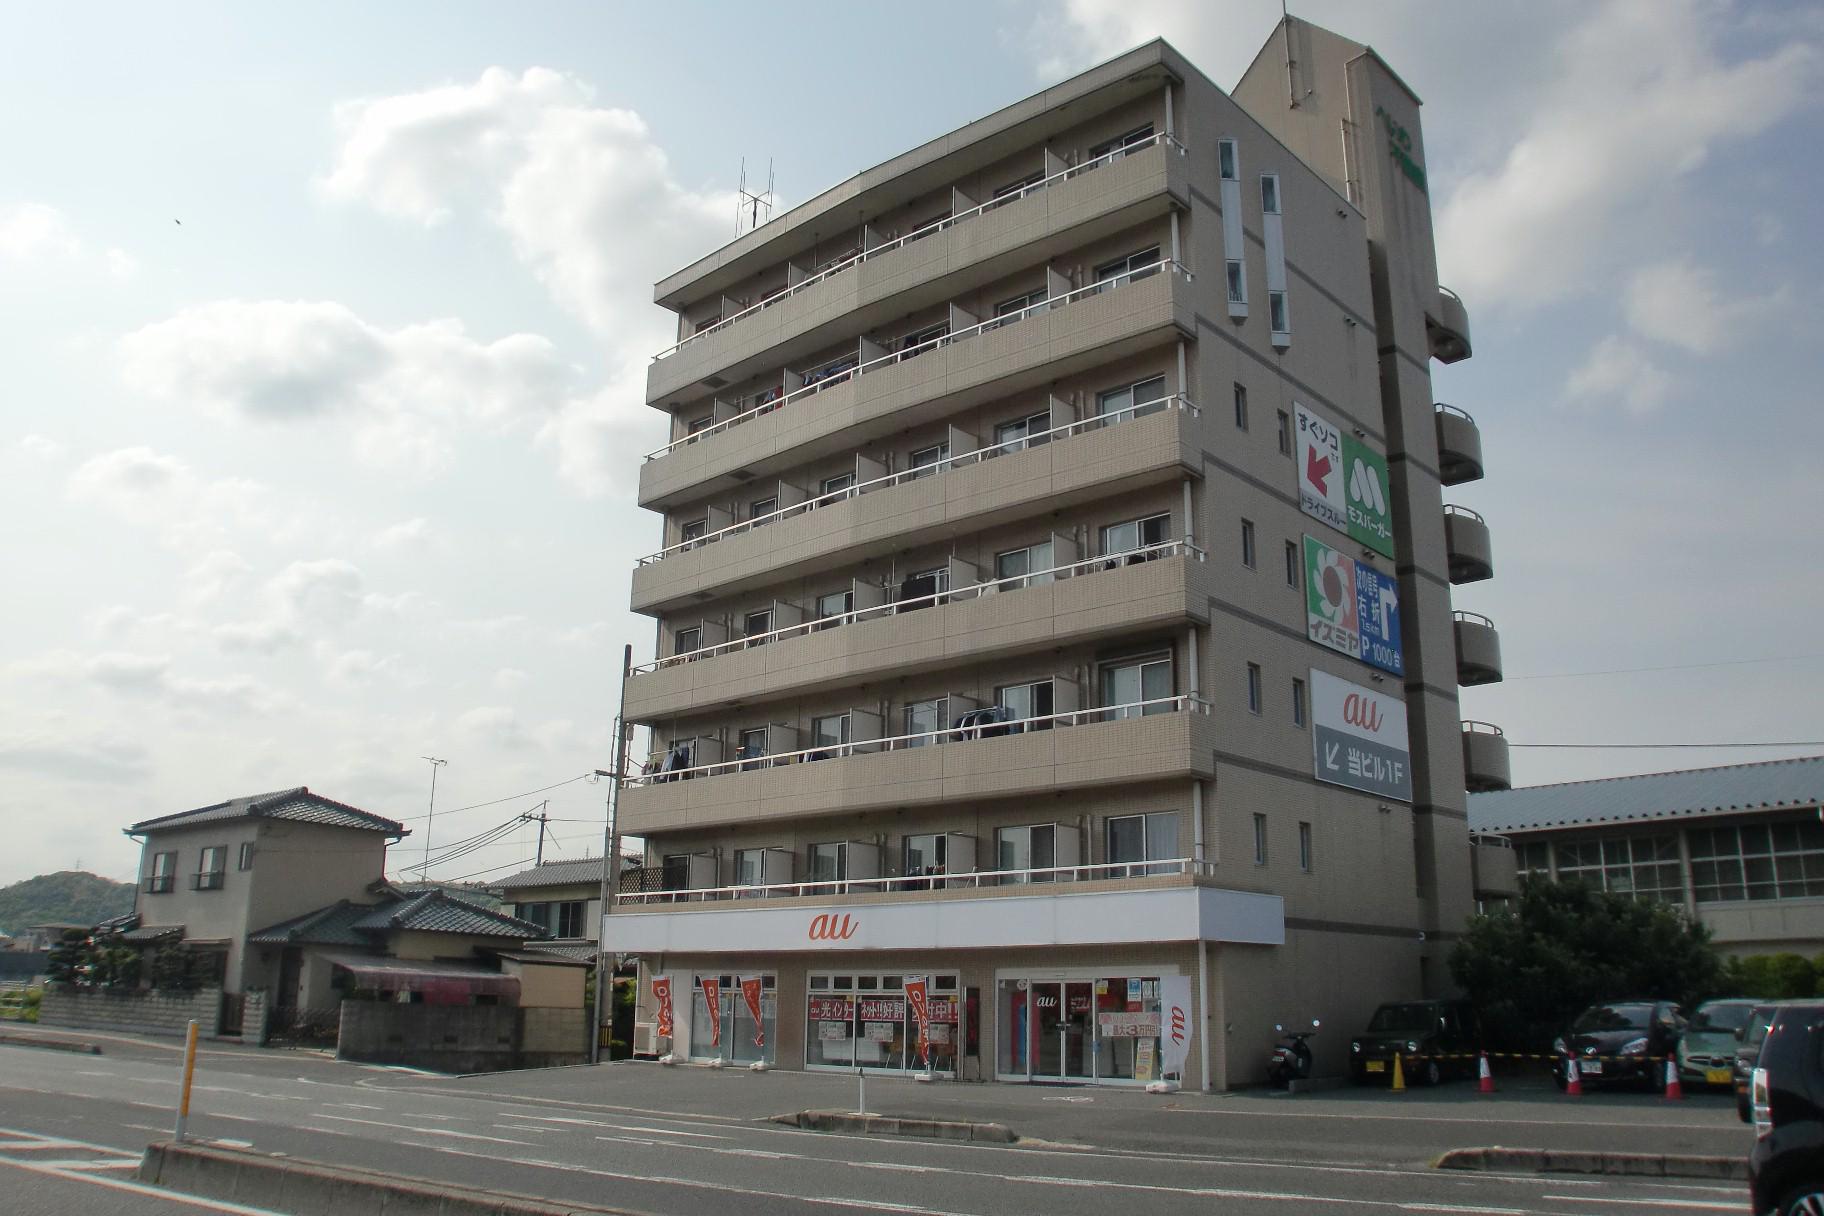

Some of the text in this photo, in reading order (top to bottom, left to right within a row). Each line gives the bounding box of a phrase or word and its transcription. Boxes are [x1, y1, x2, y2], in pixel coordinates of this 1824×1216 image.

[1347, 505, 1392, 539] モスバーガー
[1361, 635, 1370, 656] P
[1343, 693, 1384, 733] au
[1348, 747, 1403, 784] 当ビル1F
[808, 913, 860, 940] au
[1036, 995, 1058, 1008] au
[1171, 1005, 1186, 1047] au
